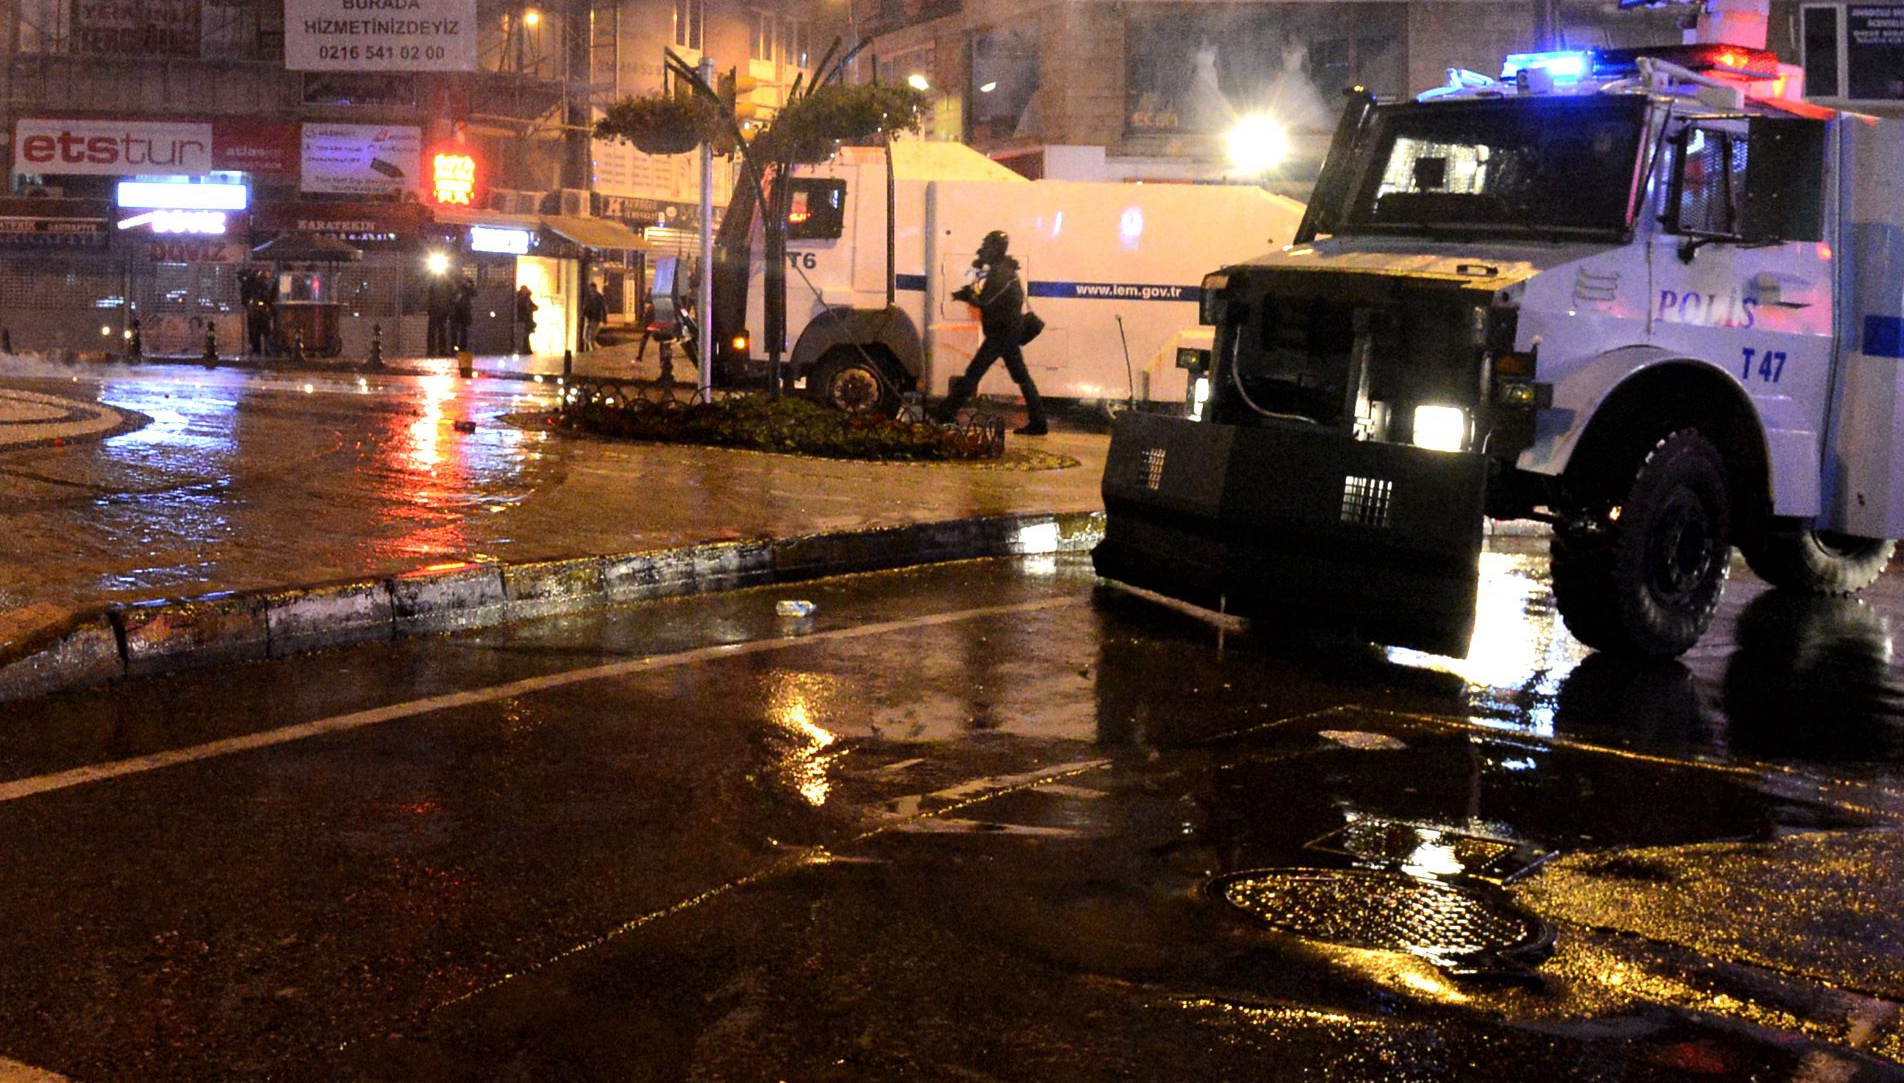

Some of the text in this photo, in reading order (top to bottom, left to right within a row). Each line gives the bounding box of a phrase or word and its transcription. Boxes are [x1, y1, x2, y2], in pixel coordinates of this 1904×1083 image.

[304, 18, 459, 35] HİZMETİNİZDEYİZ
[319, 46, 445, 60] 0216 541 02 00
[22, 130, 204, 166] etstur
[1742, 348, 1787, 382] T 47
